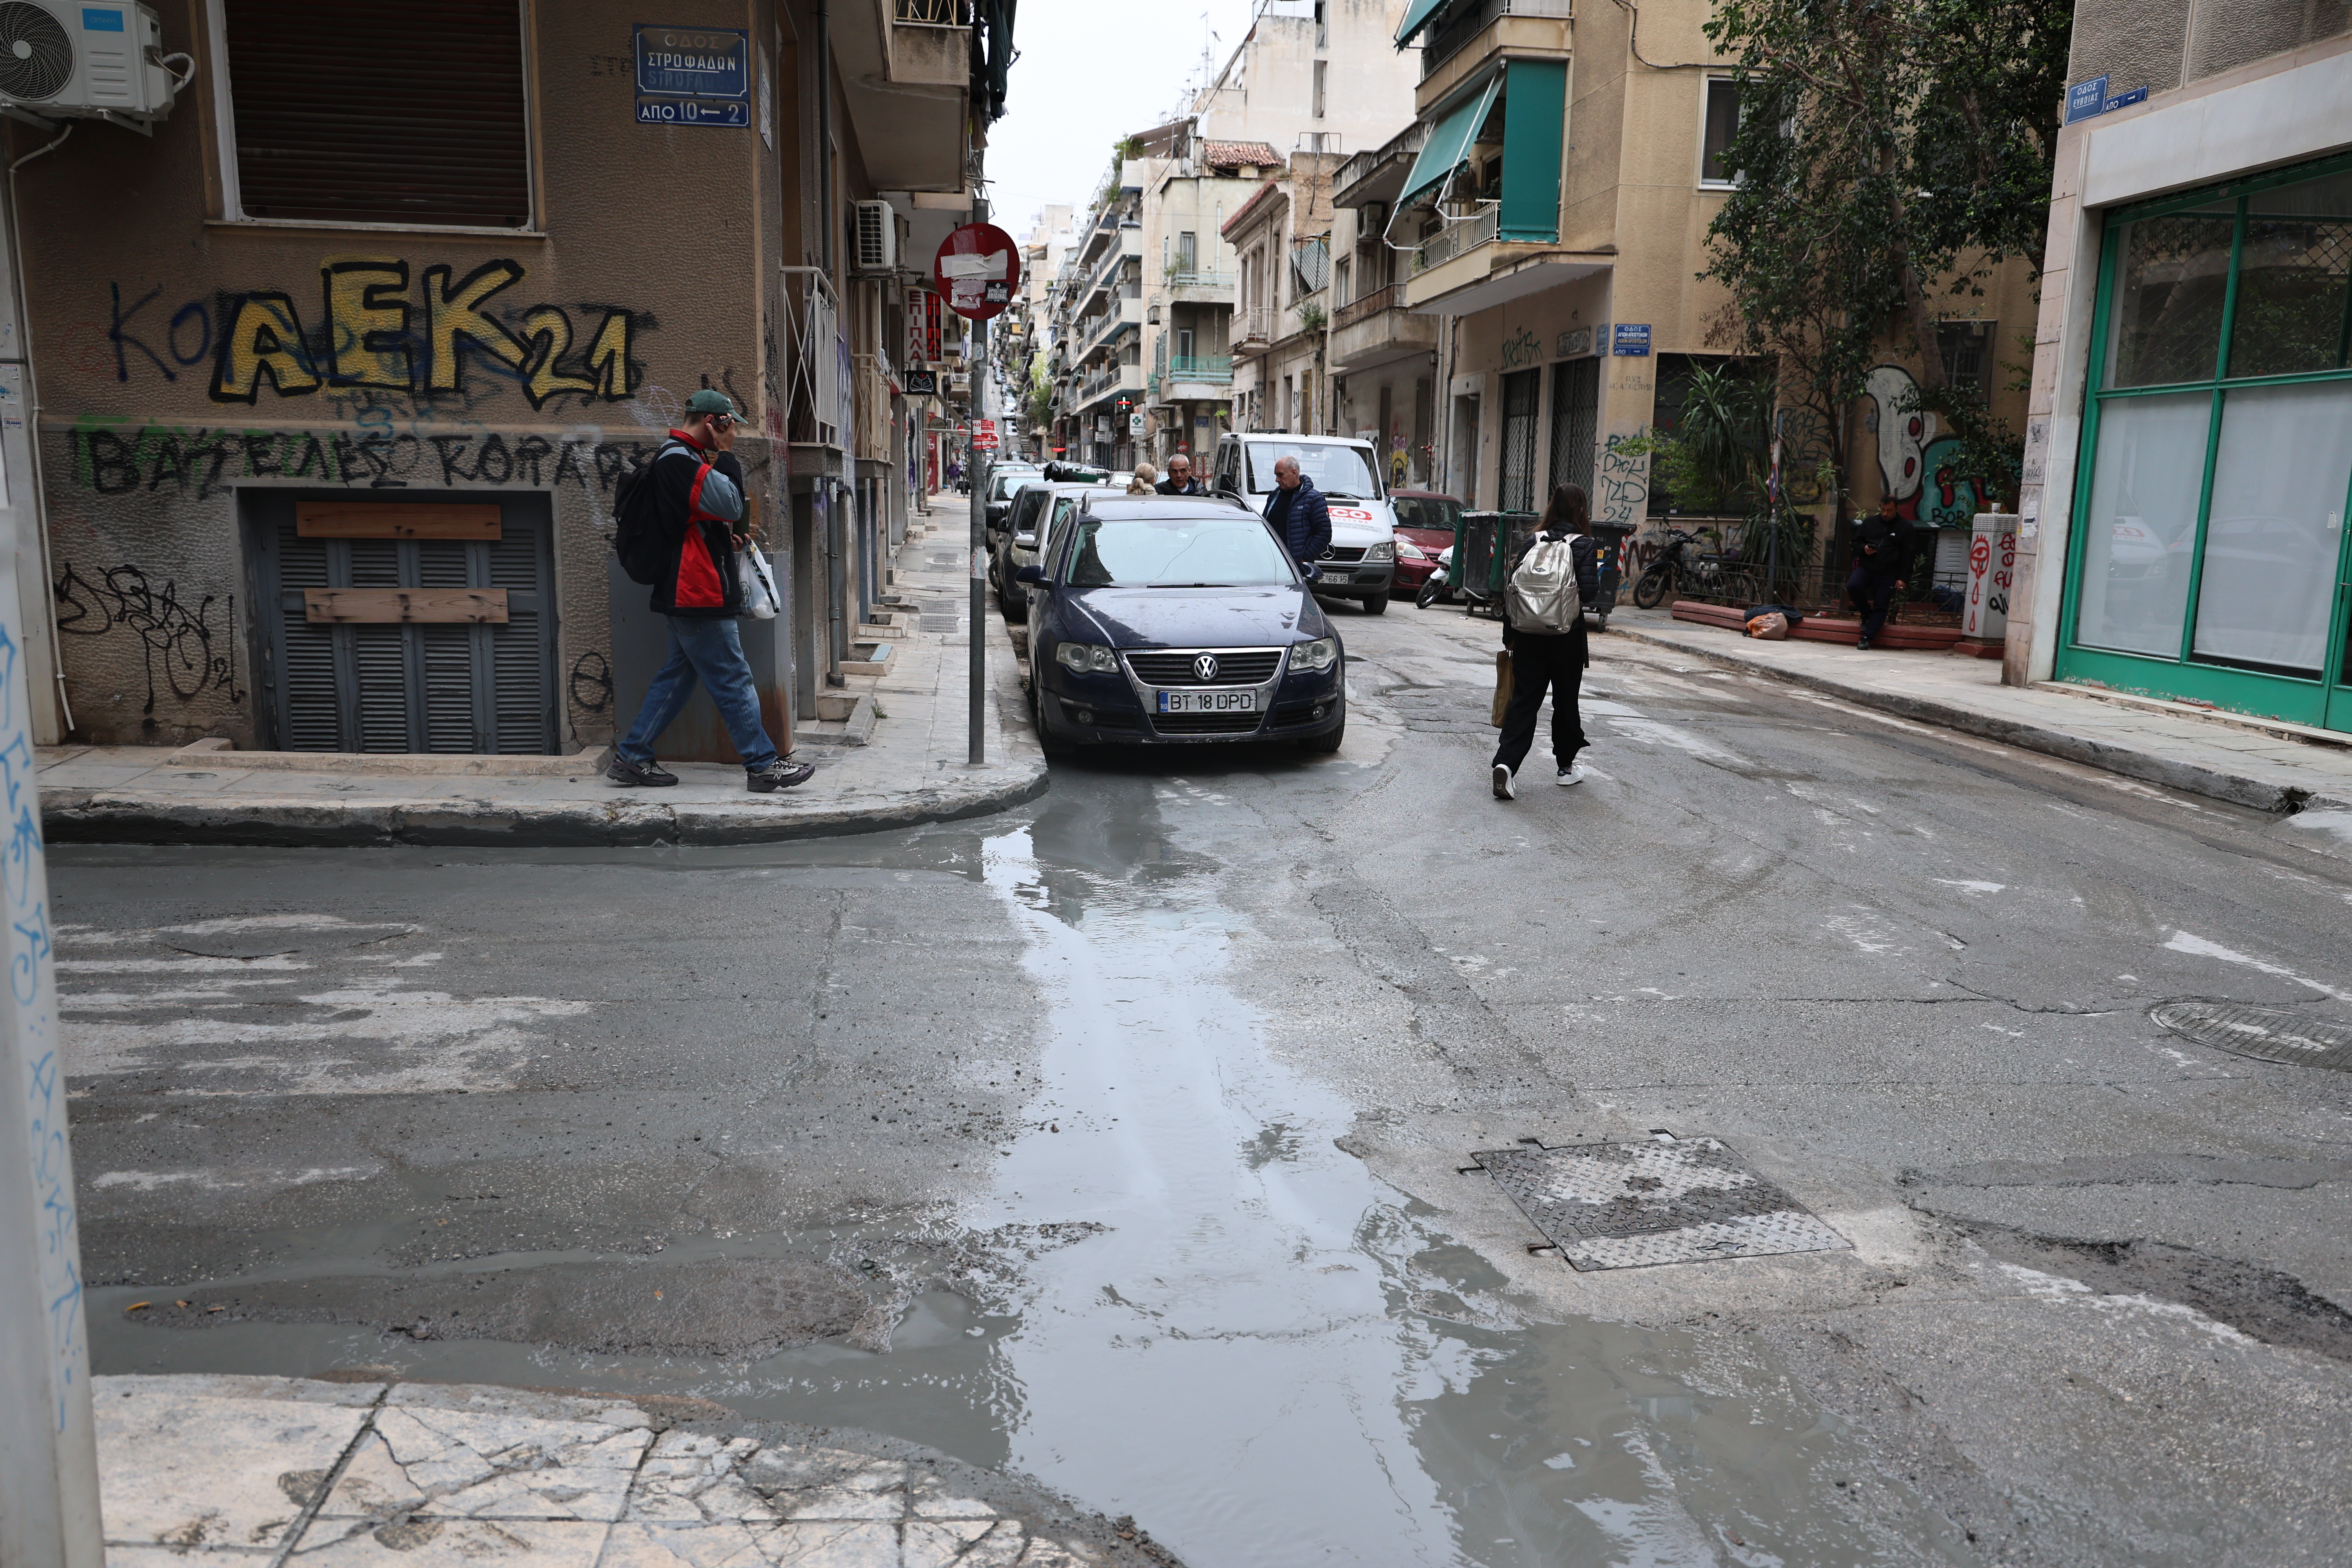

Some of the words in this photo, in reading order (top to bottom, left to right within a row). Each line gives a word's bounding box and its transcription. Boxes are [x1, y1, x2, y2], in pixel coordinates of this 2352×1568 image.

[664, 34, 719, 49] ΟΔΟΣ
[648, 52, 736, 71] ΣΤΡΟΦΑΔΩΝ
[2077, 82, 2097, 96] ΟΔΟΣ
[2073, 93, 2099, 108] ΕΥΒΟΙΑΣ
[2105, 100, 2119, 111] ΑΠΟ
[641, 105, 675, 120] ΑΠΟ
[679, 101, 697, 120] 10
[728, 104, 739, 122] 2
[909, 291, 922, 361] ΕΠΙΠΛΑ
[1171, 695, 1191, 710] BT
[1198, 694, 1212, 710] 18
[1217, 694, 1251, 709] DPD
